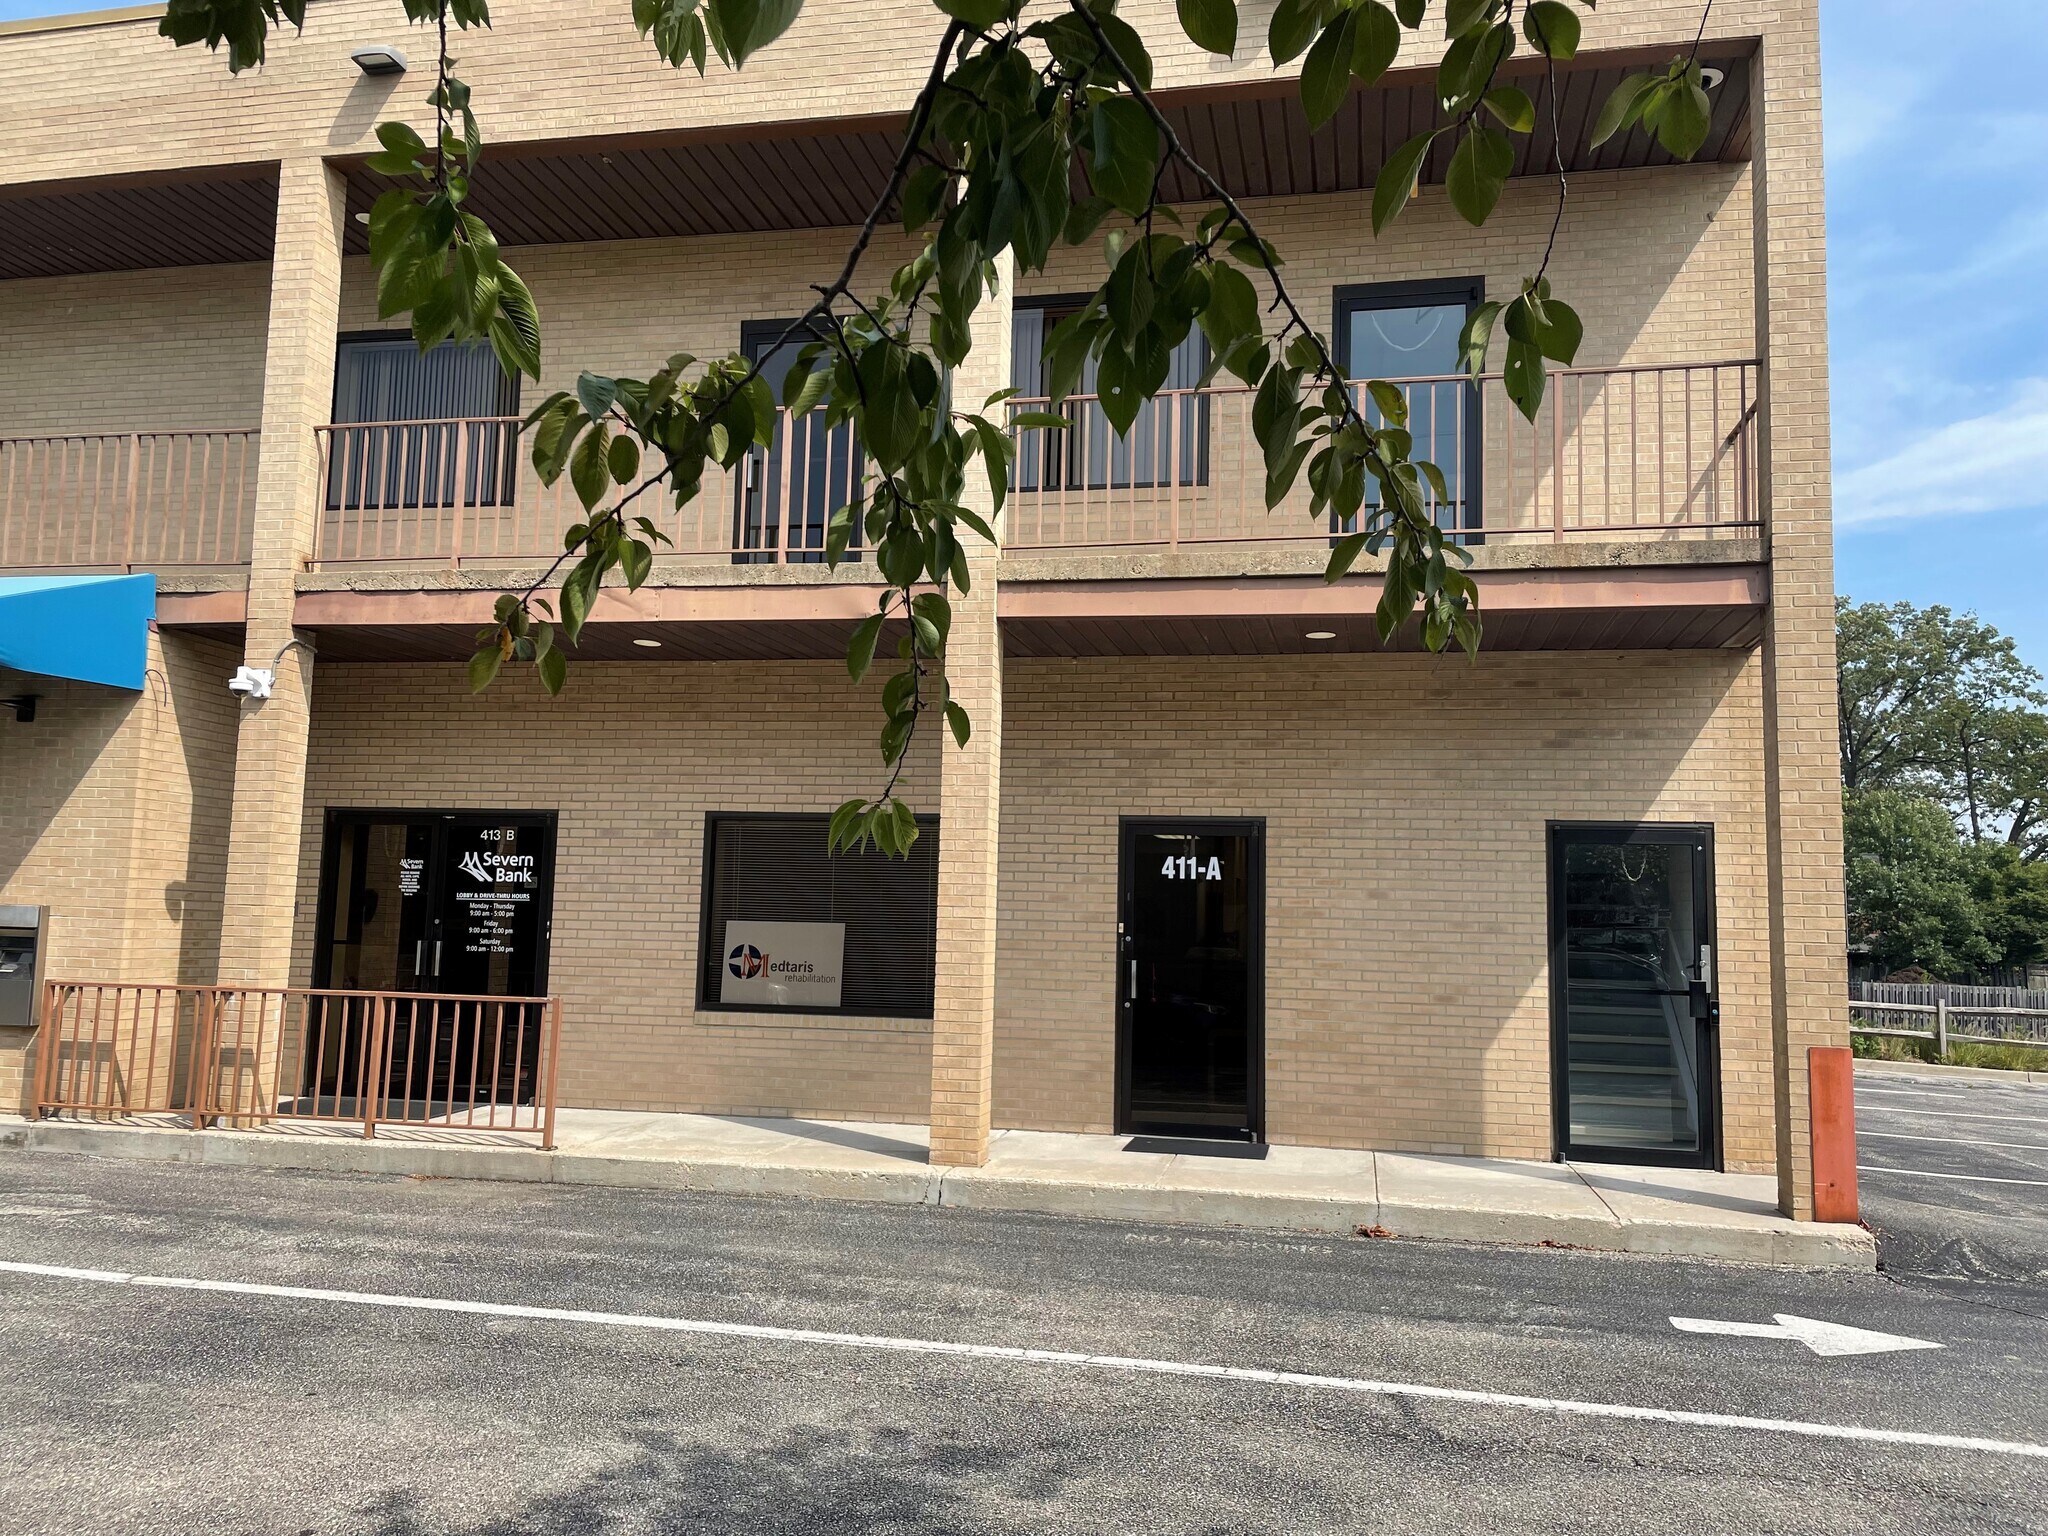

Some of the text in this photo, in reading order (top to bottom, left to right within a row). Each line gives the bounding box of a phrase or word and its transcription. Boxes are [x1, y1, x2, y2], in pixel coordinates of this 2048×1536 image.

[480, 829, 515, 841] 413 B
[482, 851, 534, 867] Severn
[1161, 855, 1222, 881] 411-A
[495, 867, 533, 883] Bank
[469, 902, 489, 911] Monday
[493, 902, 516, 911] Thursday
[469, 909, 481, 917] 9:00
[483, 920, 499, 928] Friday
[468, 926, 481, 934] 9:00
[479, 938, 501, 946] Saturday
[490, 945, 505, 953] 12:00
[740, 953, 814, 978] Medtaris
[784, 973, 837, 984] rehabilitation
